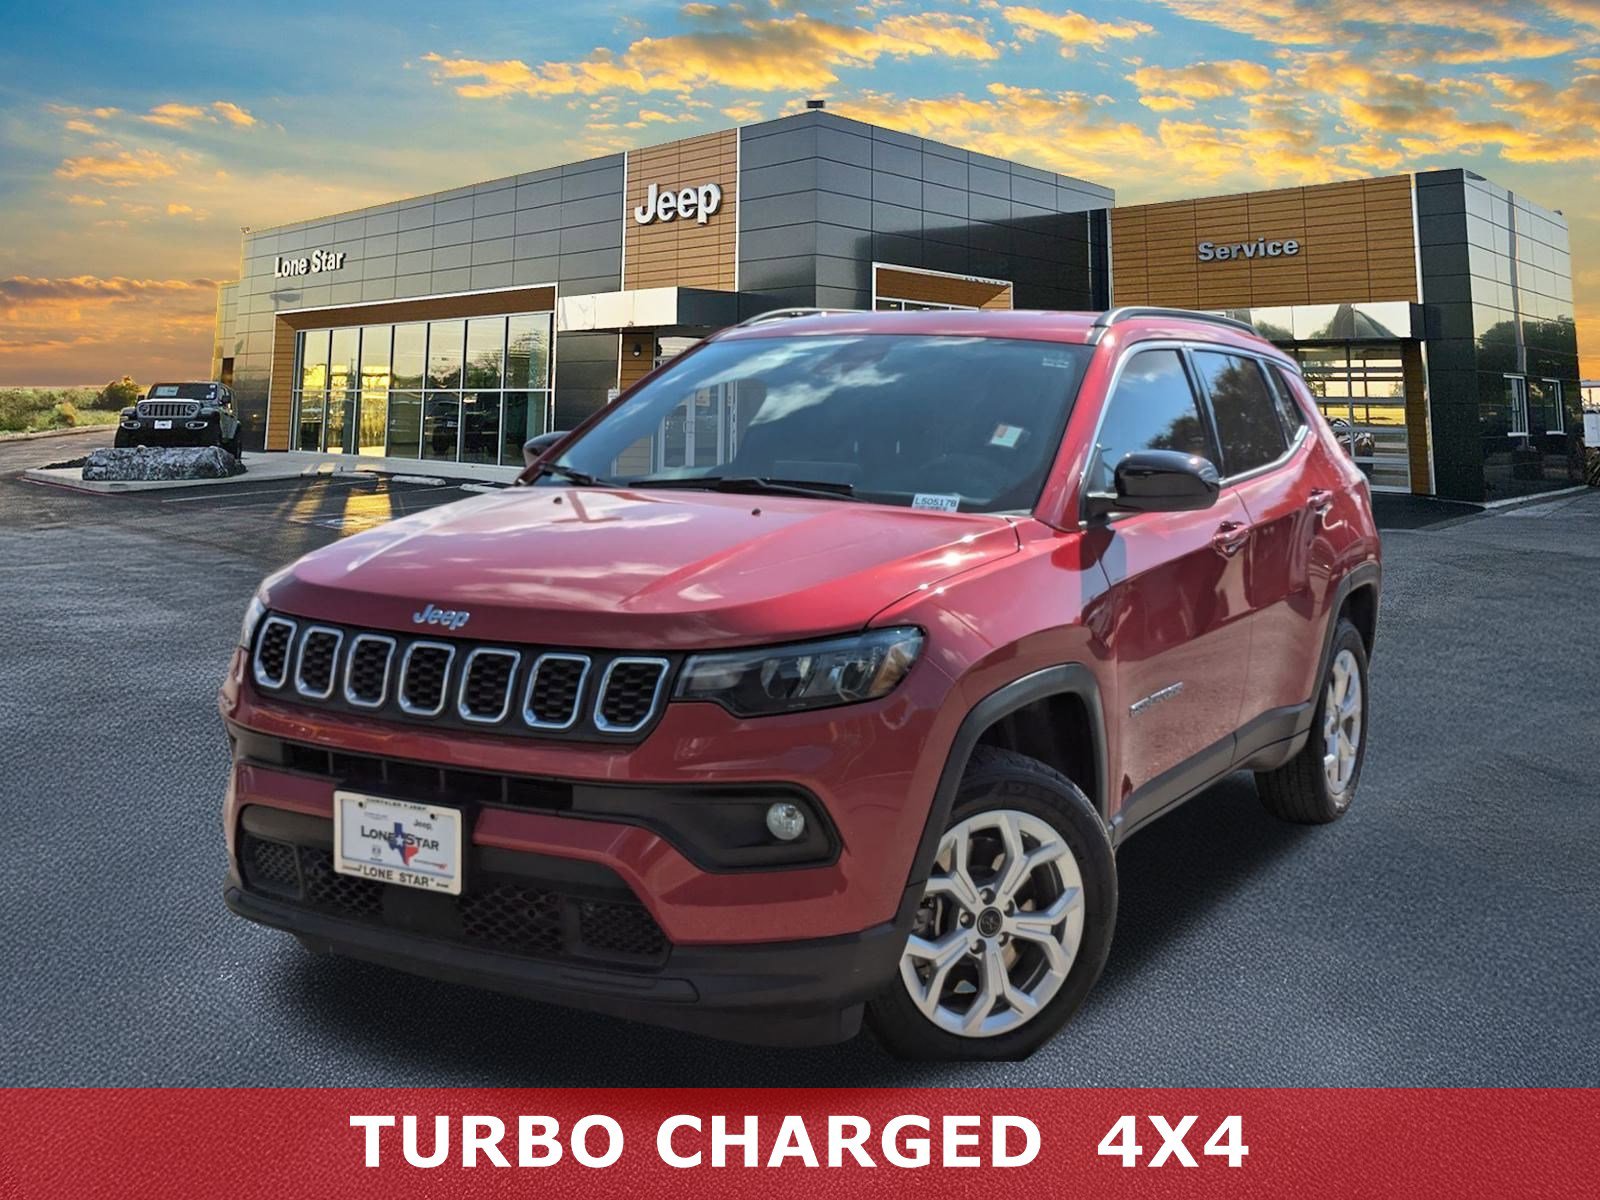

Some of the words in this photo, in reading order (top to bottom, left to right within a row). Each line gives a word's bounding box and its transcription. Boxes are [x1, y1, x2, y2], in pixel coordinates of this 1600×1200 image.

[634, 183, 722, 225] Jeep
[1198, 237, 1299, 261] Service
[274, 256, 310, 278] Lone
[311, 248, 346, 273] Star
[413, 603, 470, 630] Jeep
[361, 825, 395, 843] LONE
[405, 833, 439, 851] STAR
